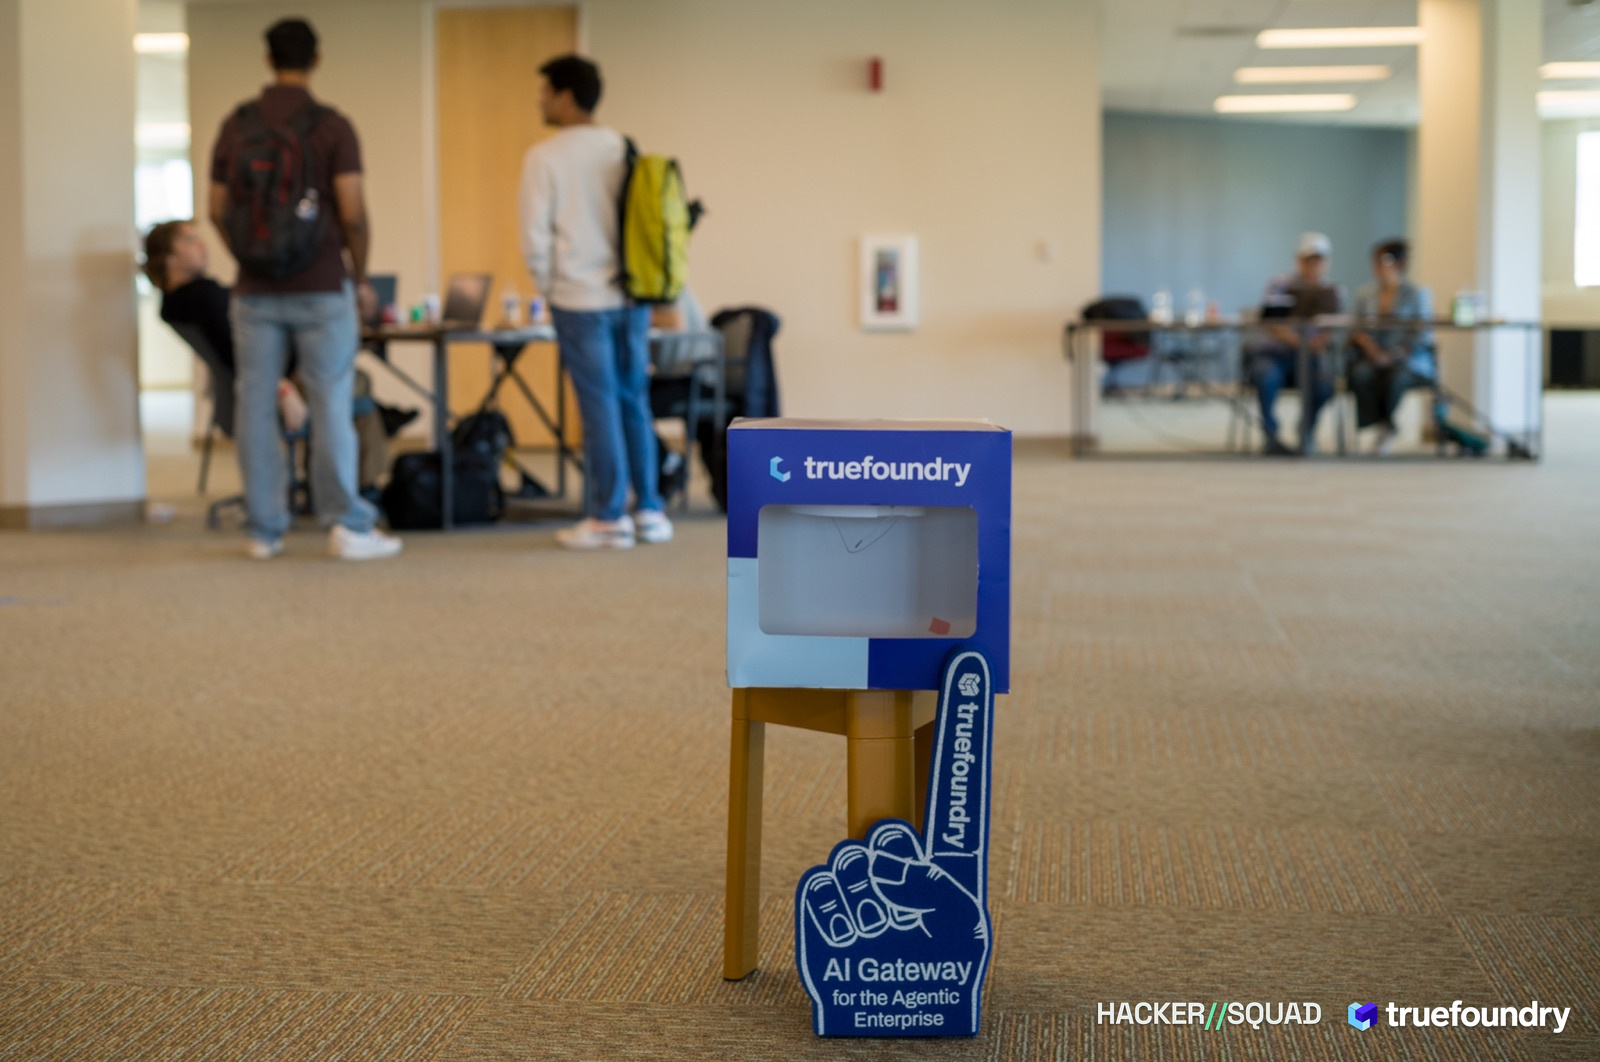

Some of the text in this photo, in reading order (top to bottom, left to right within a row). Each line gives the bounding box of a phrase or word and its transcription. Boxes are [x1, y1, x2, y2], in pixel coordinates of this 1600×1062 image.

[804, 456, 971, 487] truefoundry
[942, 701, 979, 849] truefoundry
[823, 958, 972, 986] AI Gateway
[832, 989, 960, 1009] for the Agentic
[854, 1011, 944, 1030] Enterprise
